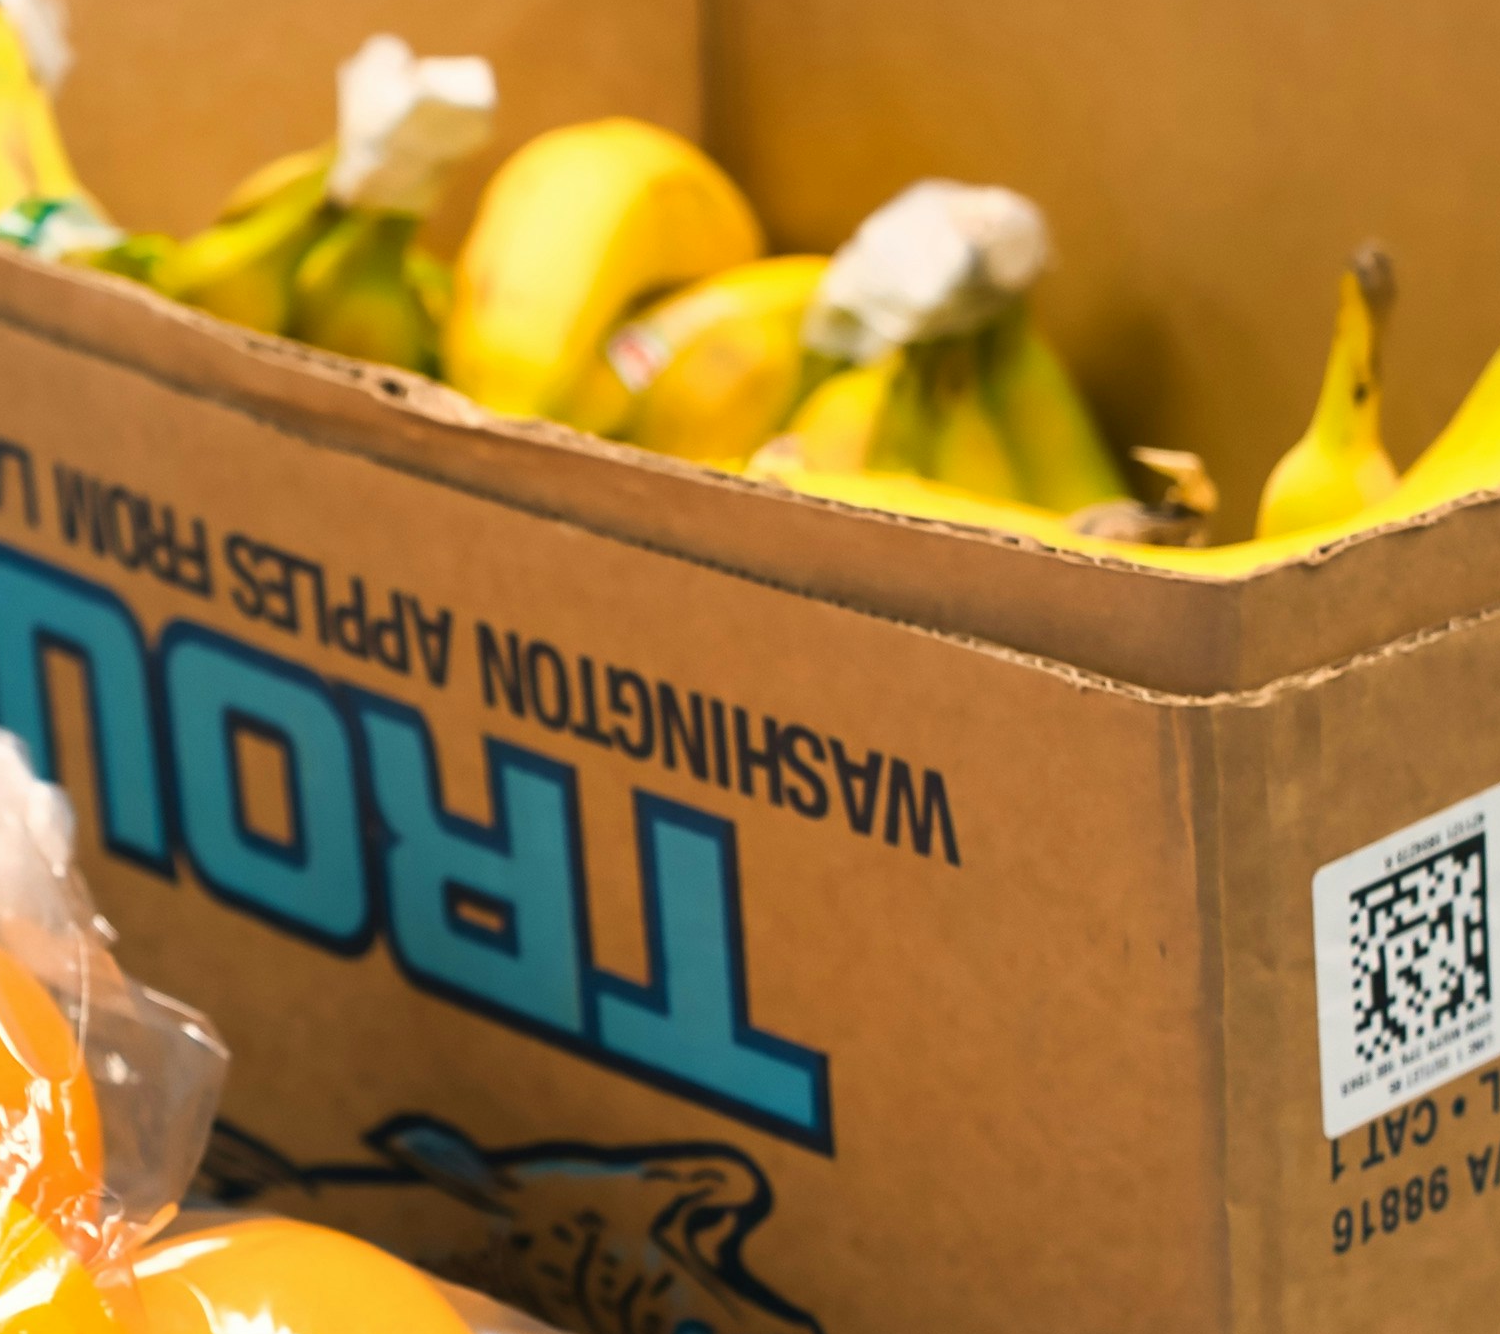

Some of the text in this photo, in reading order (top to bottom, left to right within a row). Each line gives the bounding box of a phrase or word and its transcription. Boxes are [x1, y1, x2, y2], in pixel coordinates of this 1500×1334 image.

[54, 458, 215, 600] FROM
[224, 533, 453, 690] APPLES
[475, 620, 961, 867] WASHINGTON
[1360, 1097, 1440, 1170] CAT
[1331, 1165, 1450, 1256] 98816
